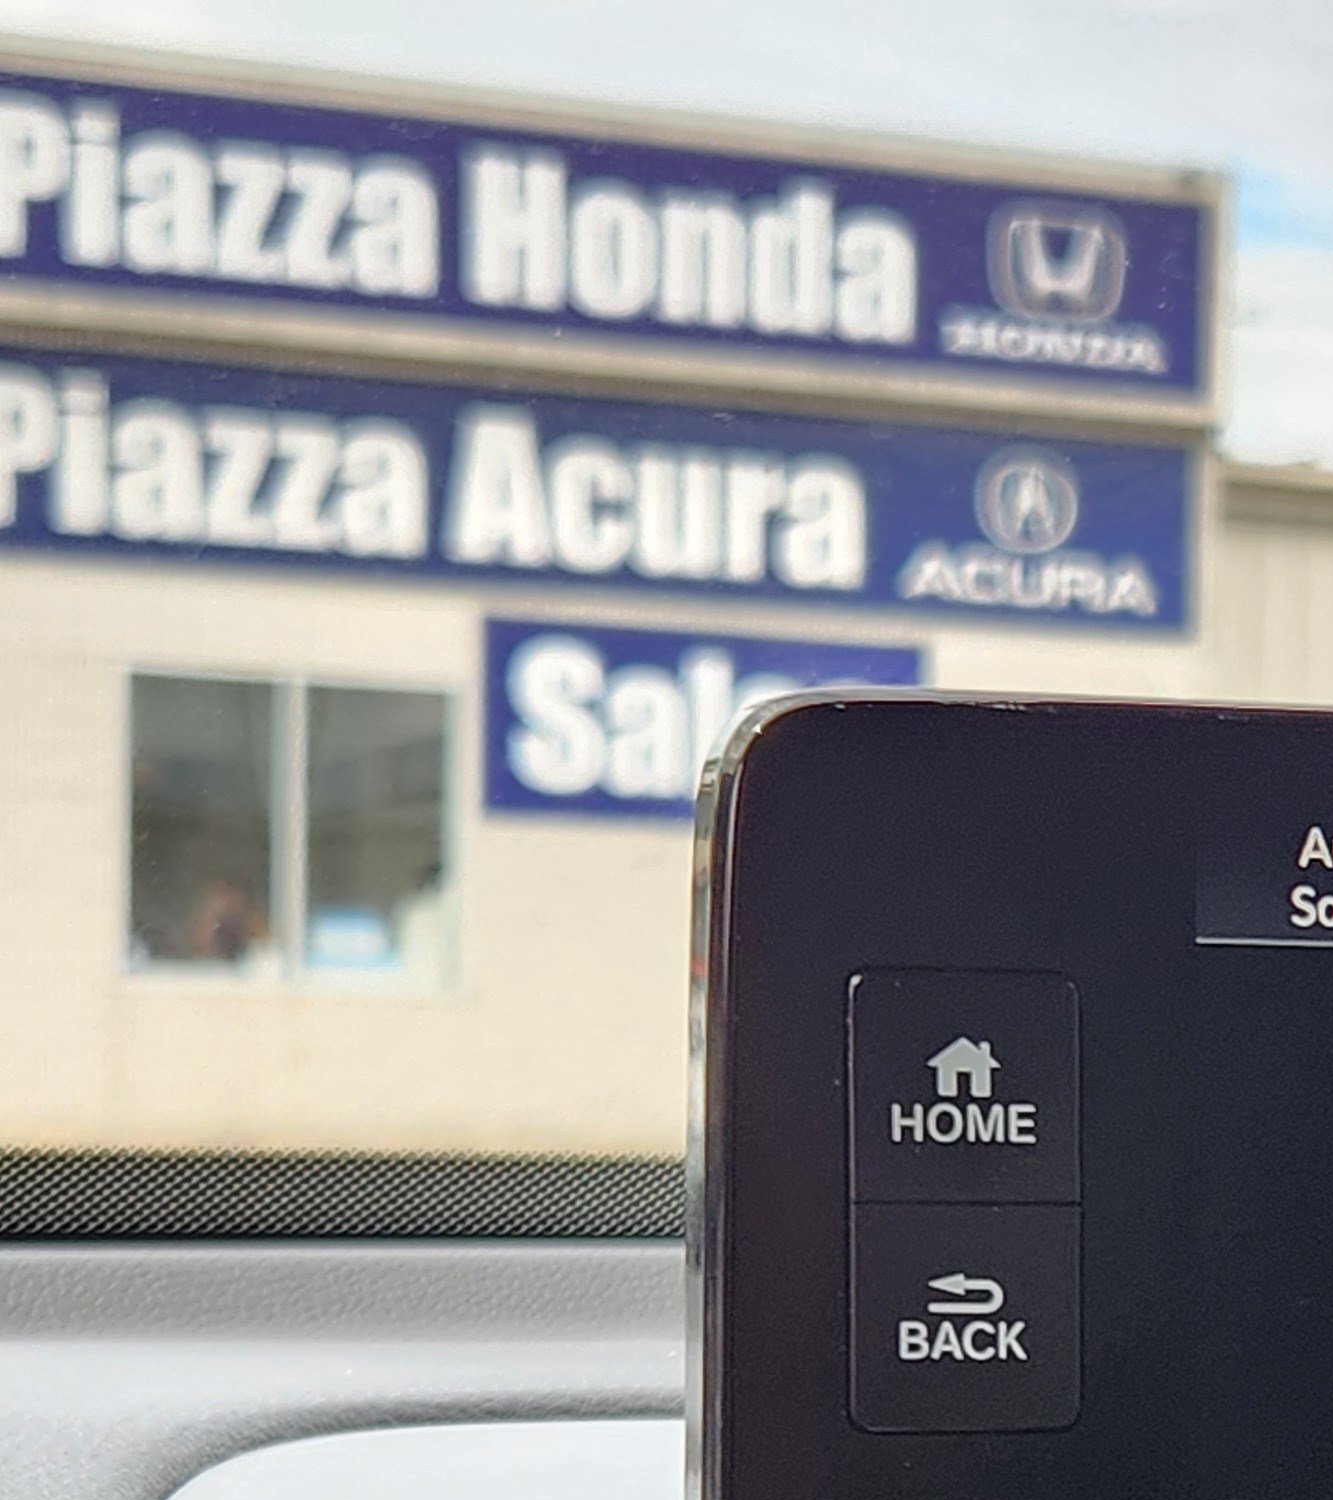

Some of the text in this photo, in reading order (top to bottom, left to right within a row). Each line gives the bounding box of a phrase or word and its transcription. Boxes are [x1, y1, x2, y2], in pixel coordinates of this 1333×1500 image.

[0, 95, 918, 346] Piazza Honda
[943, 312, 1168, 374] HONDA
[0, 365, 866, 591] Piazza Acura
[902, 548, 1157, 616] ACURA
[890, 1103, 1038, 1145] HOME
[898, 1320, 1028, 1362] BACK
